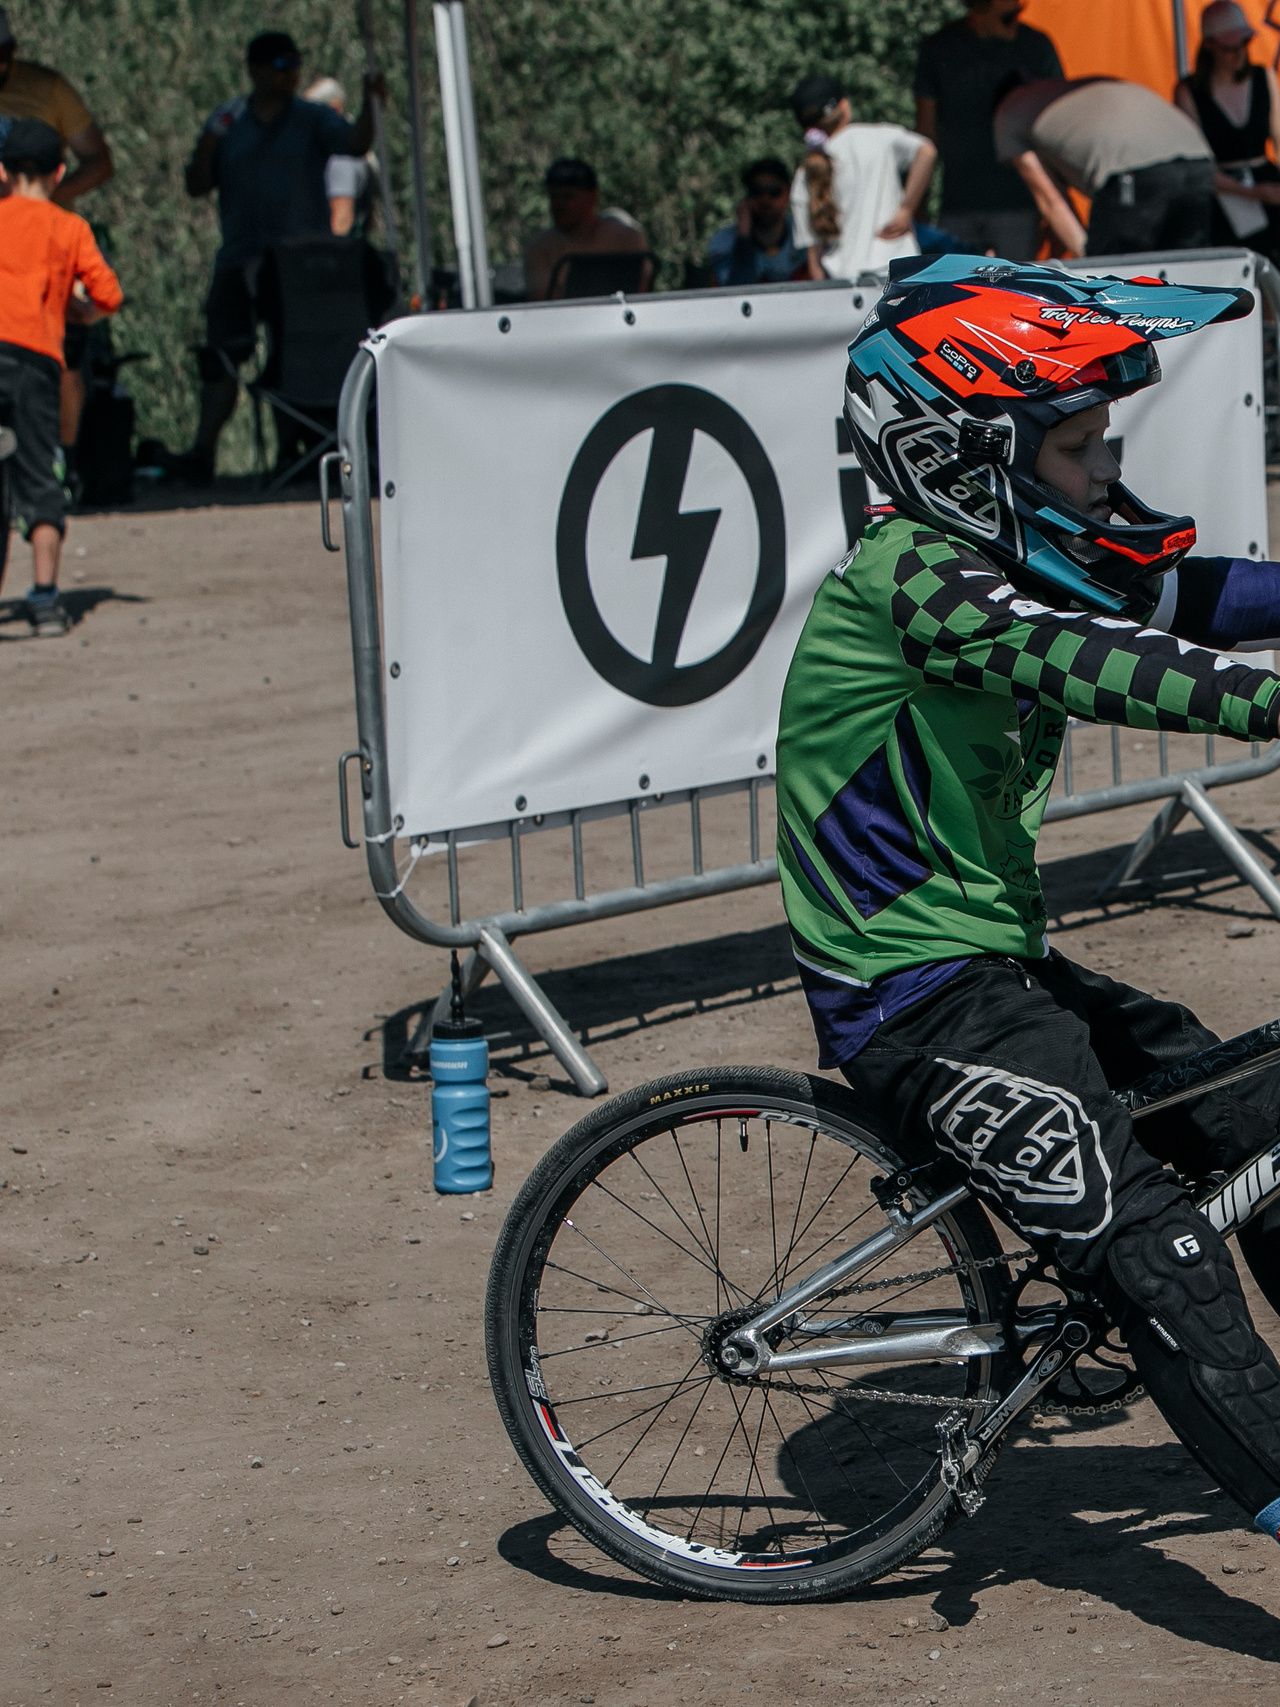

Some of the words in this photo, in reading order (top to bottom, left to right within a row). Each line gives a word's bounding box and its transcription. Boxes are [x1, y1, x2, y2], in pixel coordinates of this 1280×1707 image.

[1040, 307, 1079, 329] Troy
[1078, 311, 1113, 324] Lee
[1115, 313, 1195, 335] Designs
[942, 343, 977, 374] GoPro
[650, 1084, 710, 1105] MAXXIS
[979, 1372, 1040, 1441] ANSWER
